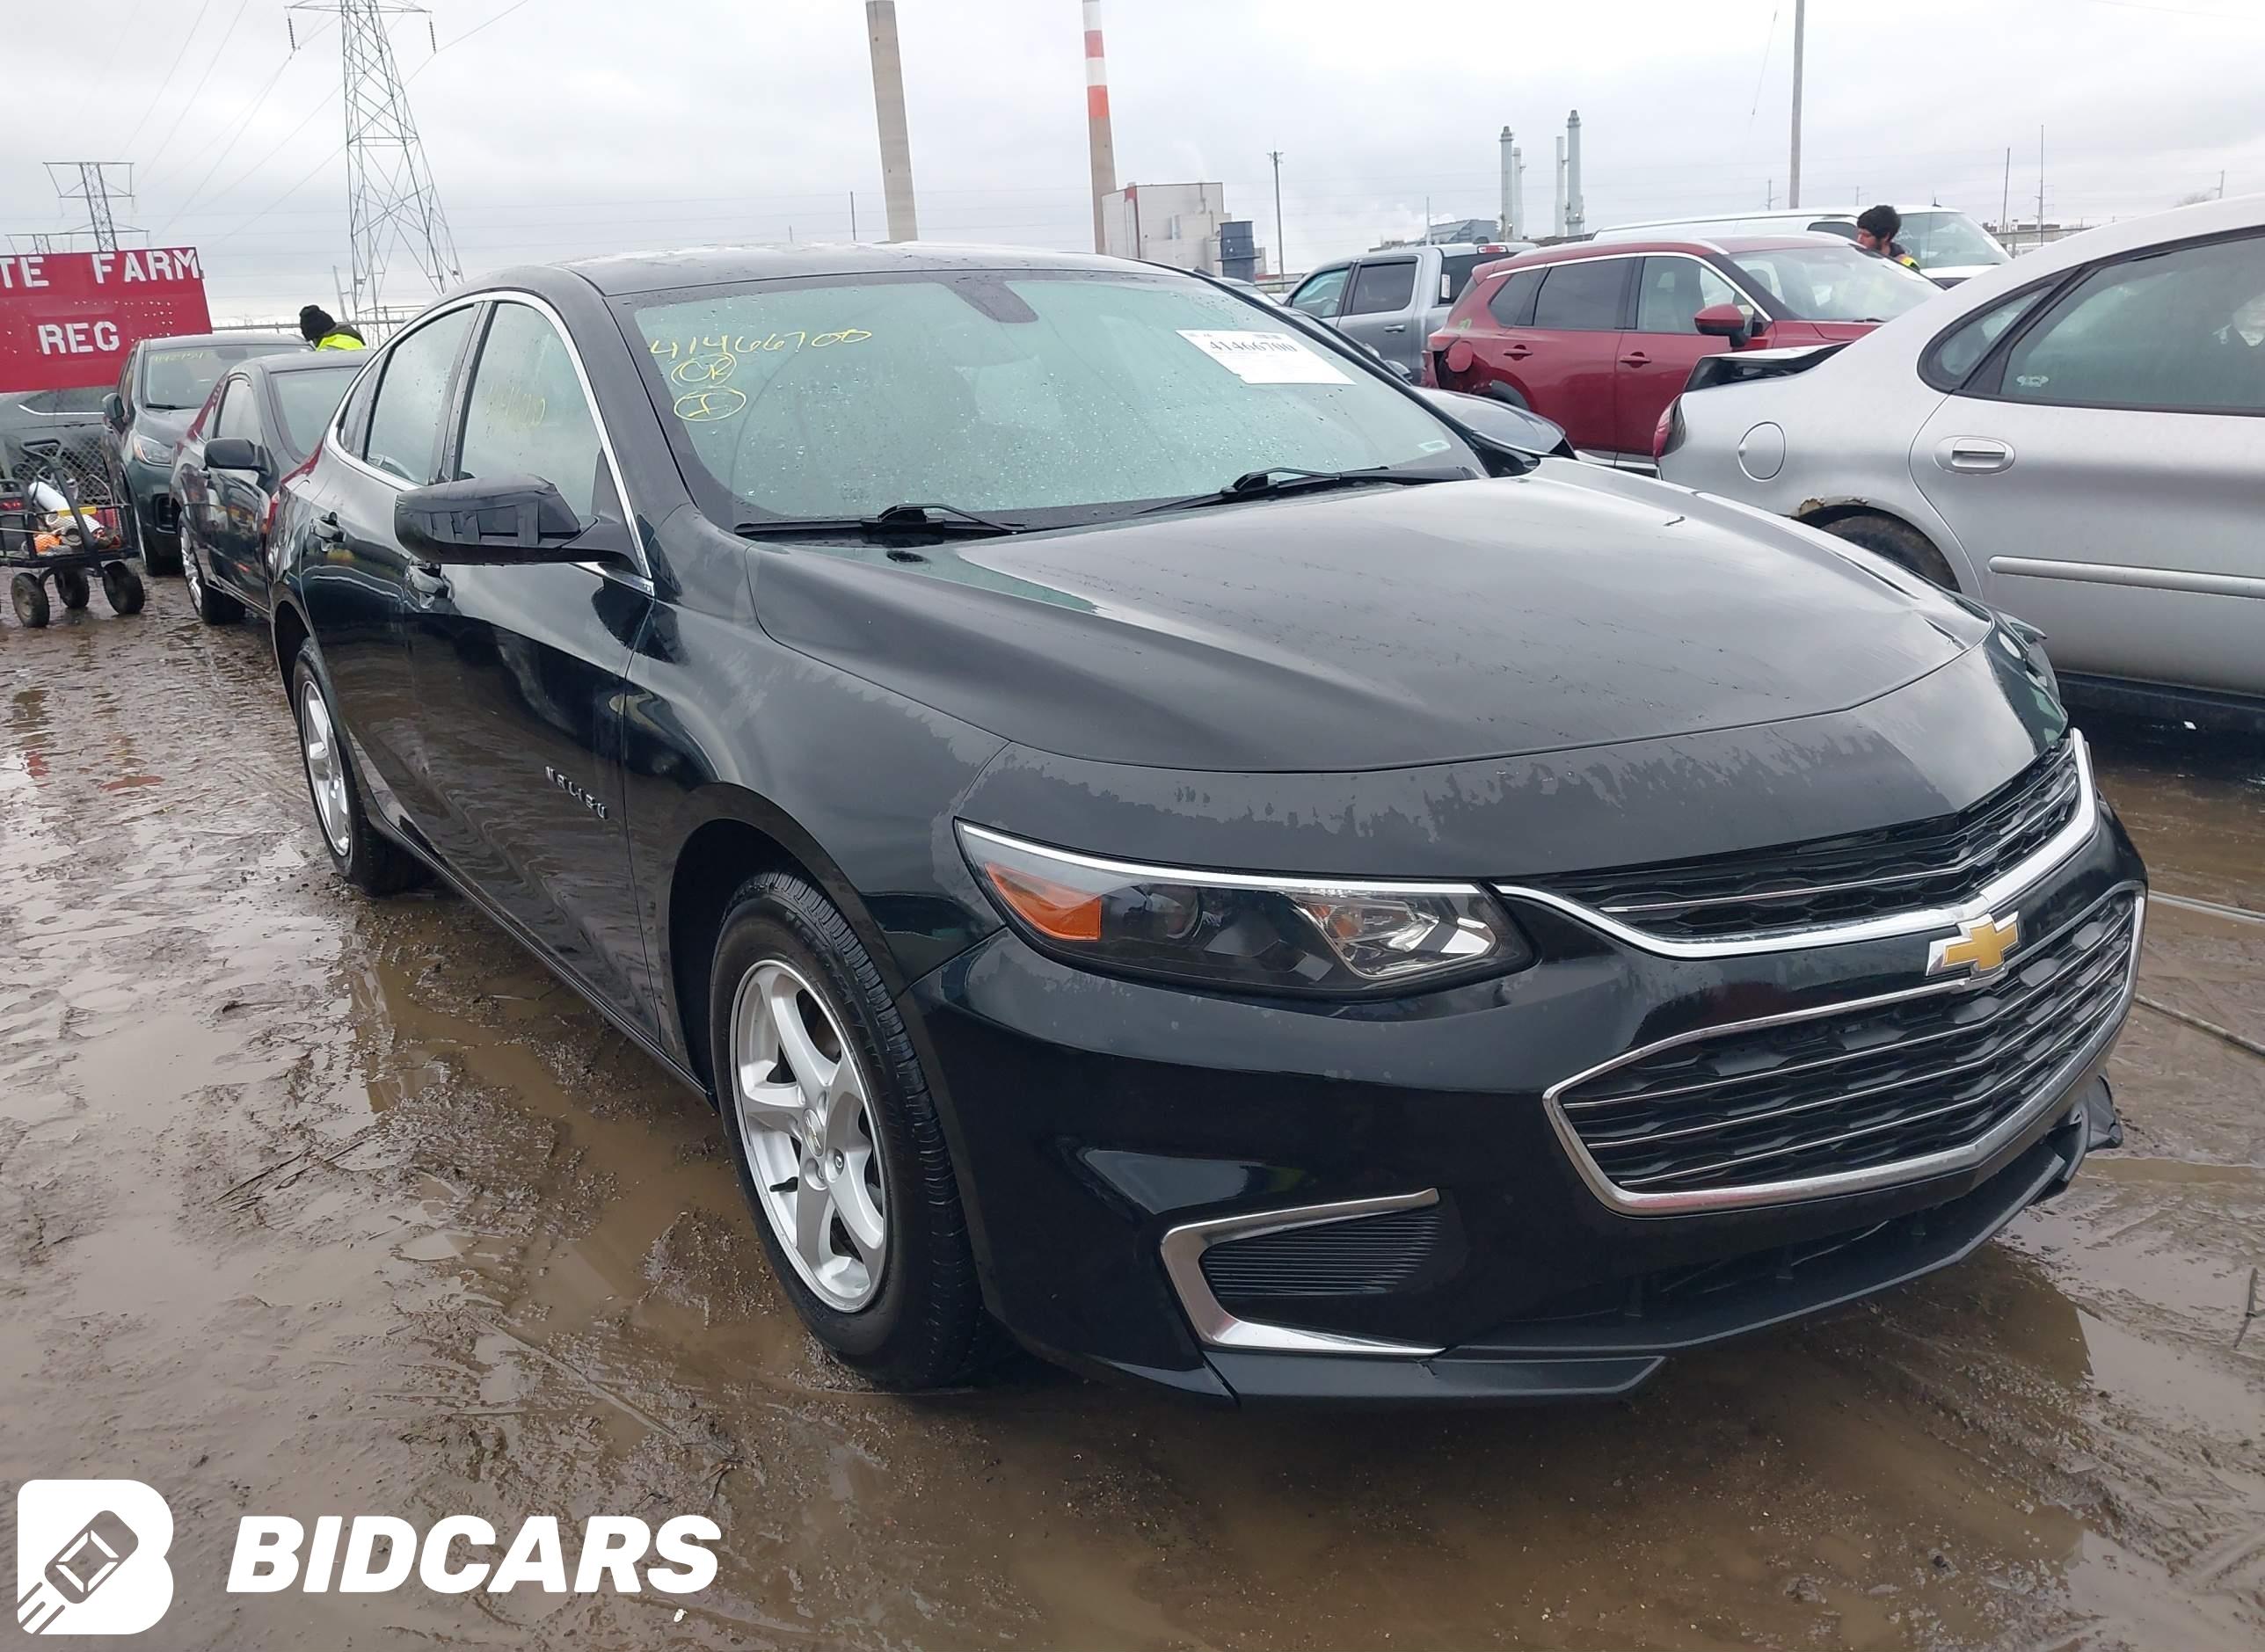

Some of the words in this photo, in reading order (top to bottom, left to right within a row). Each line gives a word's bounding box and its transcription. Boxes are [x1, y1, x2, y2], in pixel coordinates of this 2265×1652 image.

[91, 249, 200, 285] FARM
[37, 320, 120, 356] REG
[650, 328, 873, 359] 41466700
[1208, 340, 1299, 353] 41466700
[544, 765, 608, 820] MALIBU
